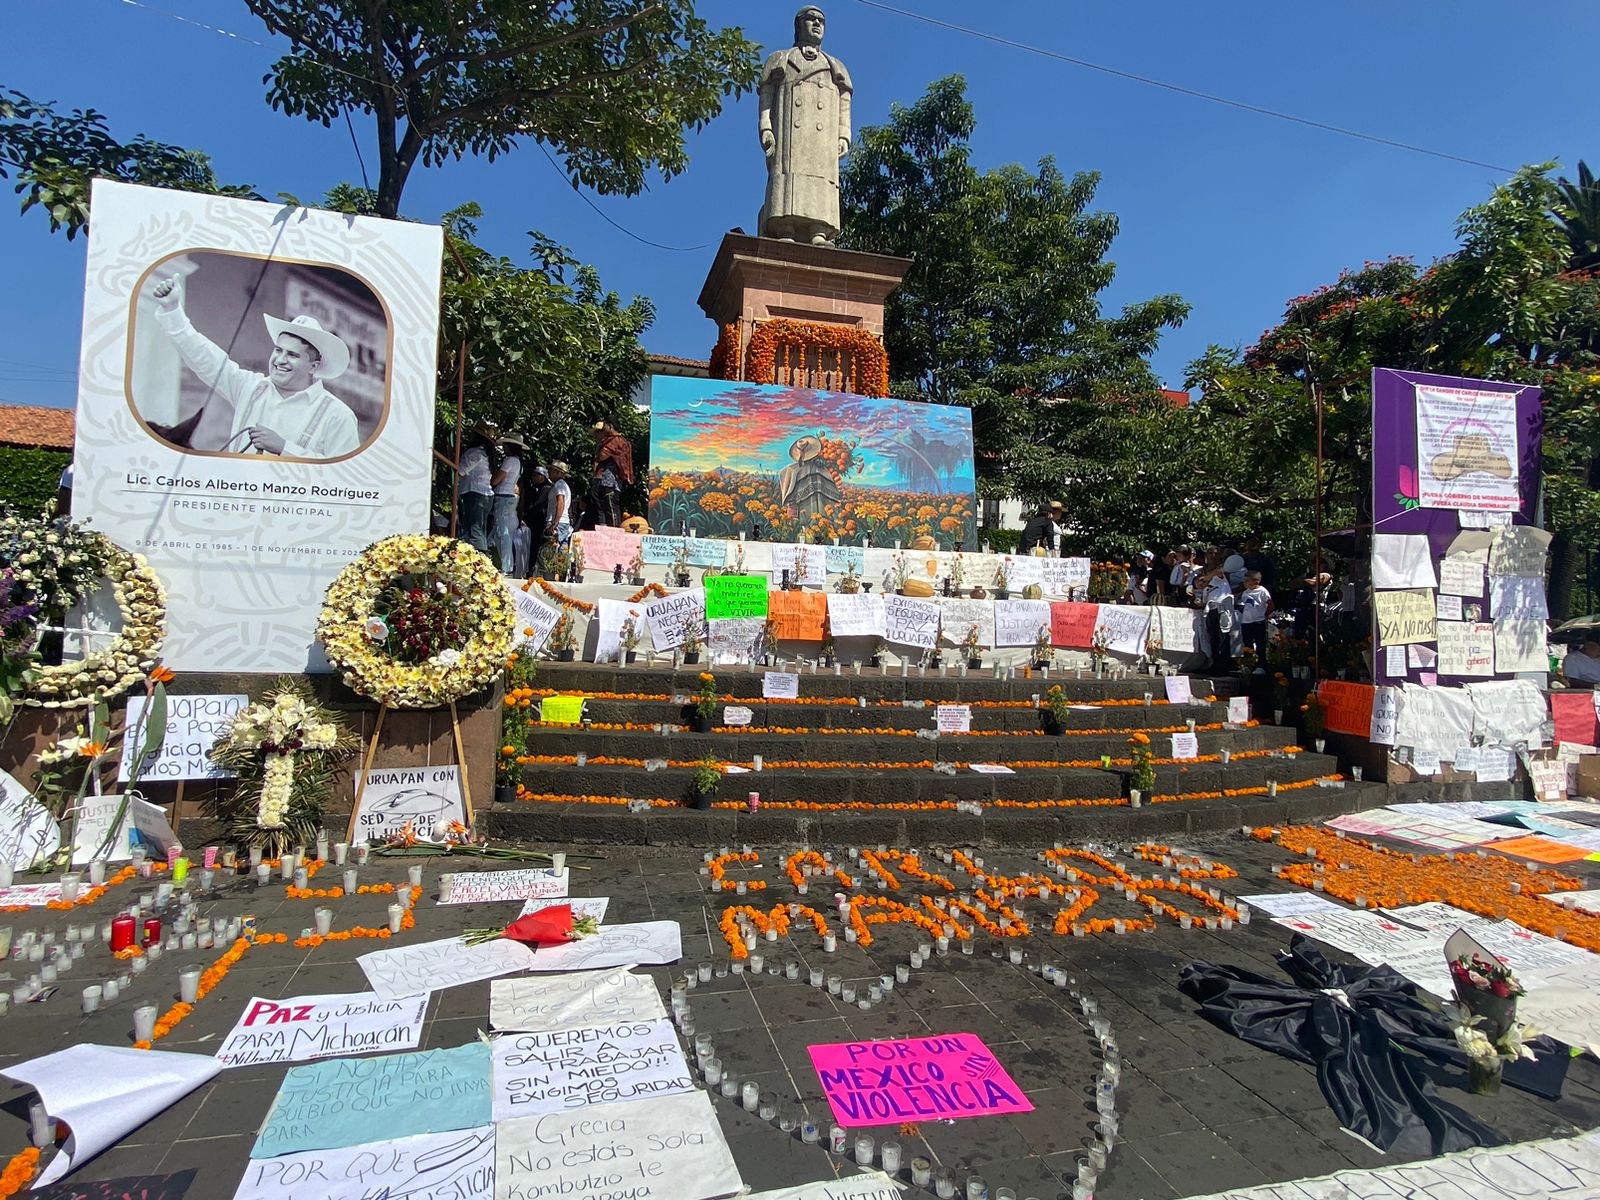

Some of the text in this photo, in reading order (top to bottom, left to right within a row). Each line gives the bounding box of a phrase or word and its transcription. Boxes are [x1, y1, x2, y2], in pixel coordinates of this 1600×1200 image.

[127, 474, 380, 500] Lic. Carlos Alberto Manzo Rodríguez
[174, 500, 333, 517] PRESIDENTE MUNICIPAL
[162, 541, 191, 549] ABRIL
[196, 542, 208, 550] DE
[268, 546, 322, 555] NOVIEMBRE
[326, 548, 338, 556] DE
[520, 597, 556, 626] URUAPAN
[647, 595, 698, 618] URUAPAN
[887, 606, 939, 624] SEGURIDAD
[893, 597, 934, 613] EXIGIMOS
[1103, 606, 1148, 627] QUEREMOS
[895, 618, 928, 633] PAZ
[1000, 619, 1040, 630] JUSTICIA
[1403, 620, 1415, 638] NO
[892, 629, 936, 646] URUAPAN
[1376, 724, 1392, 734] NO
[367, 770, 455, 786] URUAPAN CON
[360, 813, 436, 826] SED DE
[376, 965, 440, 985] VIVE
[511, 983, 548, 1001] La
[592, 986, 620, 1007] la
[243, 1001, 317, 1026] PAZ
[316, 1011, 330, 1022] y
[227, 1030, 285, 1050] PARA
[288, 1022, 410, 1057] Michoacán
[516, 1025, 652, 1051] QUEREMOS
[505, 1042, 619, 1067] SALIR A
[541, 1043, 678, 1072] TRABAJAR
[846, 1036, 968, 1064] POR UN
[290, 1065, 322, 1088] SI
[336, 1059, 378, 1080] NO
[381, 1050, 437, 1075] HAY
[960, 1052, 992, 1078] SIN
[280, 1065, 453, 1109] JUSTICIA PARA
[506, 1076, 550, 1092] SIN
[510, 1077, 619, 1105] EXIGIMOS
[564, 1077, 695, 1108] SEGURIDAD
[270, 1078, 492, 1125] PUEBLO QUE NO HAYA
[830, 1078, 1021, 1121] VIOLENCIA
[261, 1124, 315, 1147] PARA
[535, 1113, 627, 1147] Grecia
[256, 1149, 410, 1188] POR QUE
[509, 1150, 552, 1175] No
[636, 1162, 665, 1178] te
